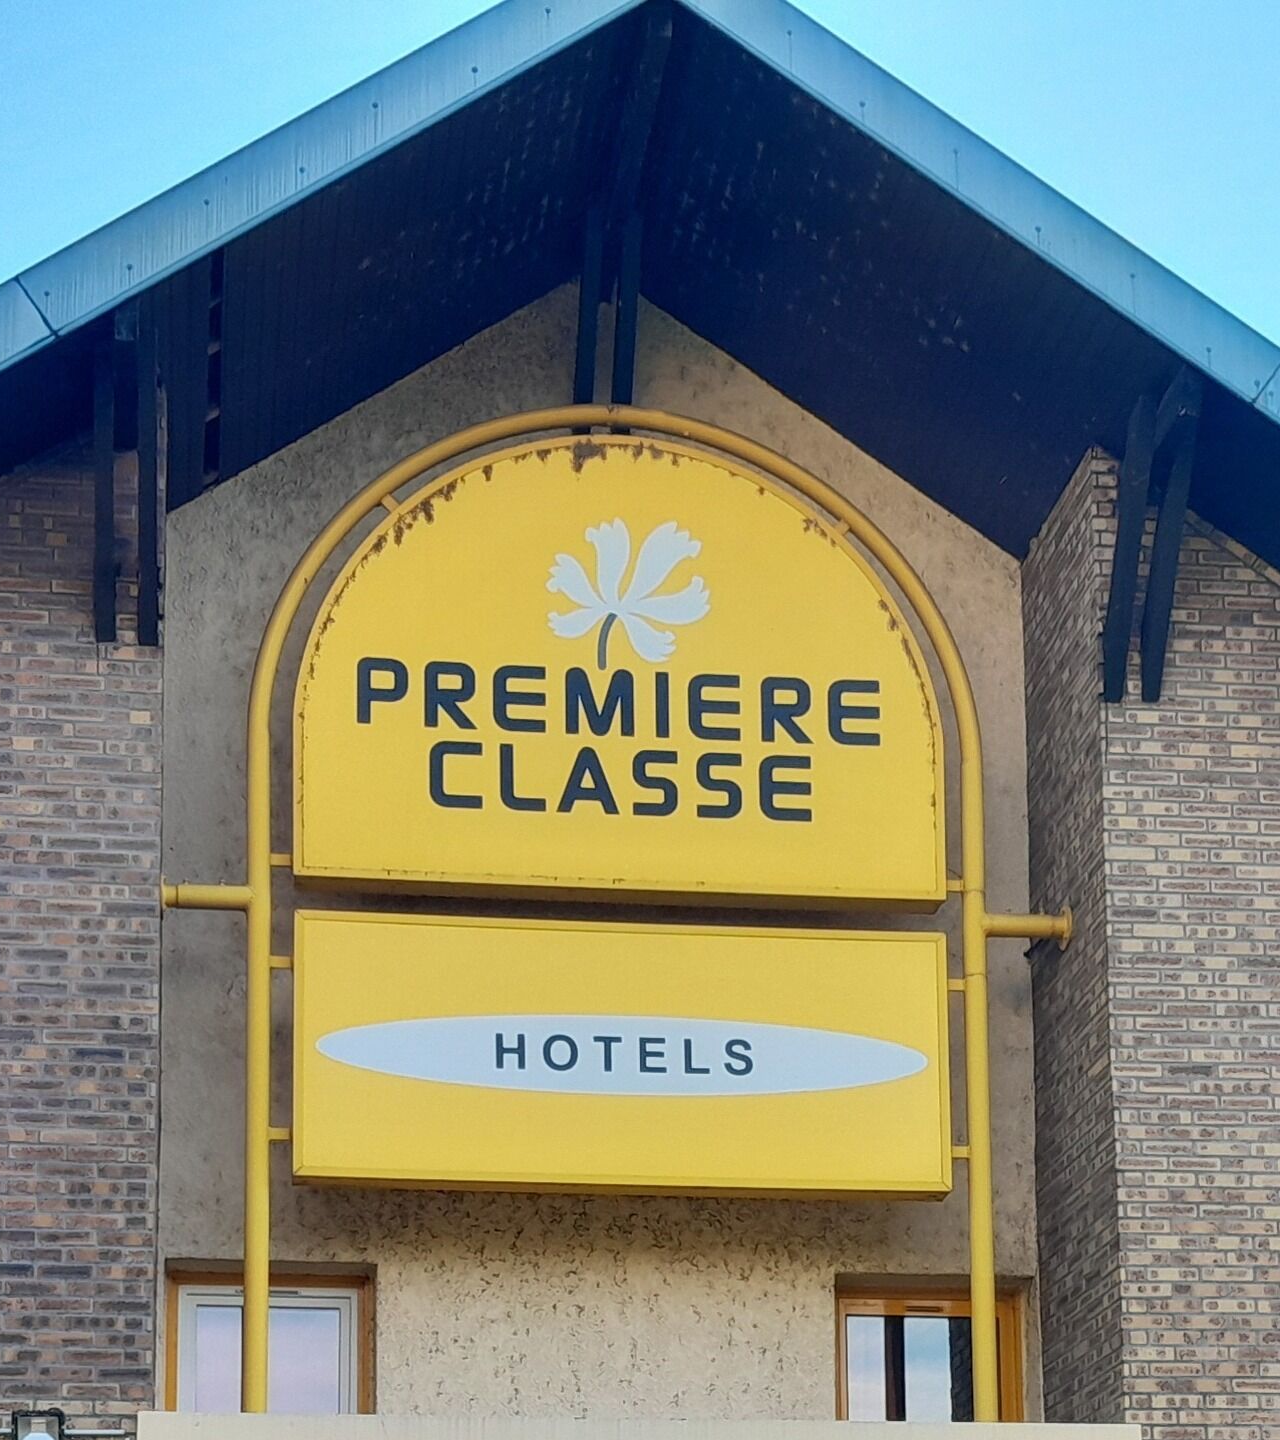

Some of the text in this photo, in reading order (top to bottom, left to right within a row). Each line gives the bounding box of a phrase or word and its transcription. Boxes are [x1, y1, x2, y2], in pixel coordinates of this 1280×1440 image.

[356, 656, 881, 747] PREMIERE
[429, 740, 813, 822] CLASSE
[494, 1032, 755, 1077] HOTELS
